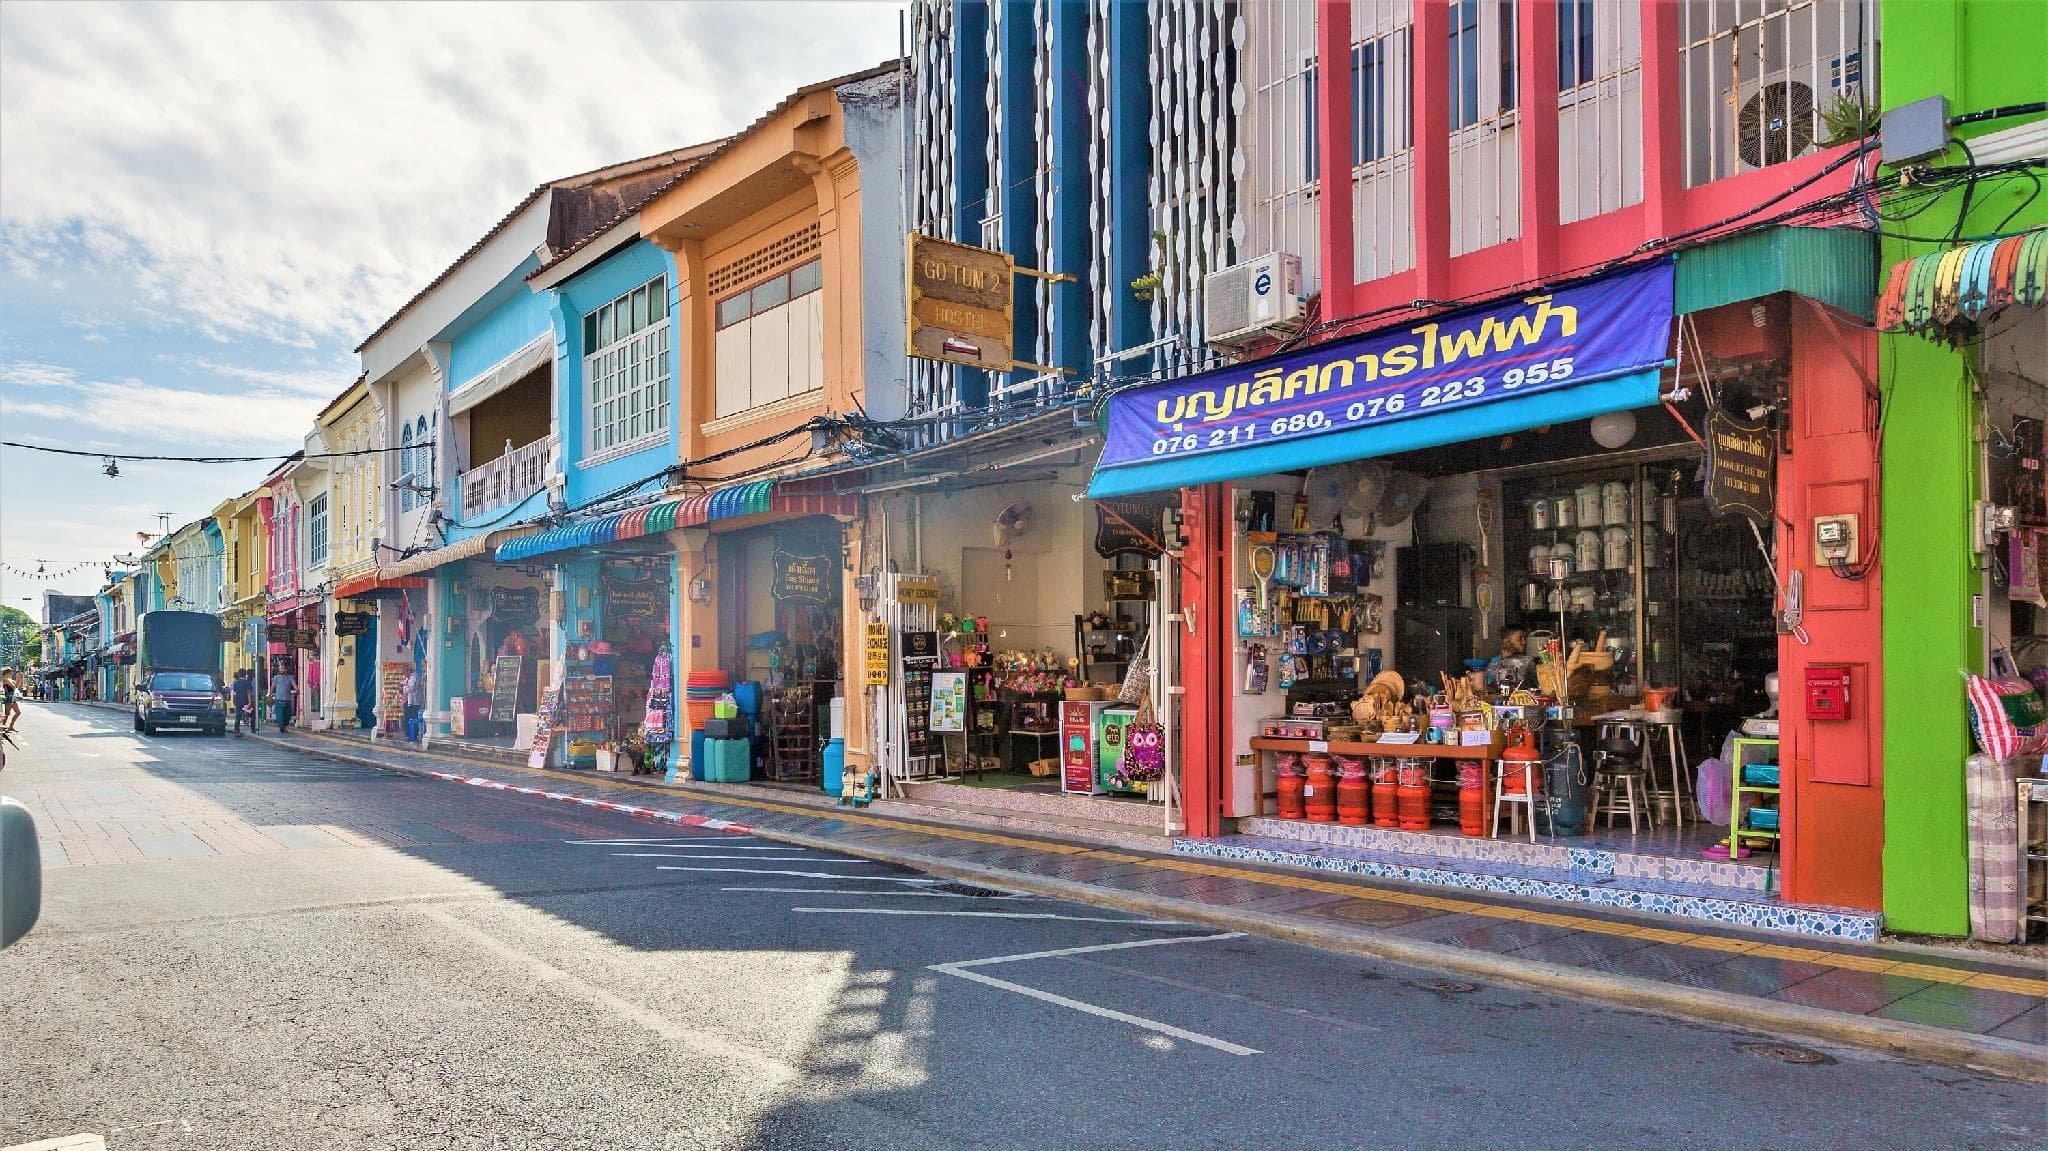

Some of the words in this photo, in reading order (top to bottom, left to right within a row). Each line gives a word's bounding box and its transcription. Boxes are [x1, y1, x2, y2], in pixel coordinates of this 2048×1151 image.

[925, 261, 947, 281] GO
[953, 265, 984, 290] TUM
[990, 275, 1000, 294] 2
[936, 306, 986, 330] HOSTEL
[1157, 294, 1578, 431] บุญเลิศการไฟฟ้า
[1153, 434, 1198, 455] 076
[1208, 423, 1255, 447] 211
[1270, 410, 1332, 436] 680,
[1346, 393, 1405, 421] 076
[1420, 376, 1485, 408] 223
[1502, 357, 1574, 389] 955
[868, 624, 886, 636] MONEY
